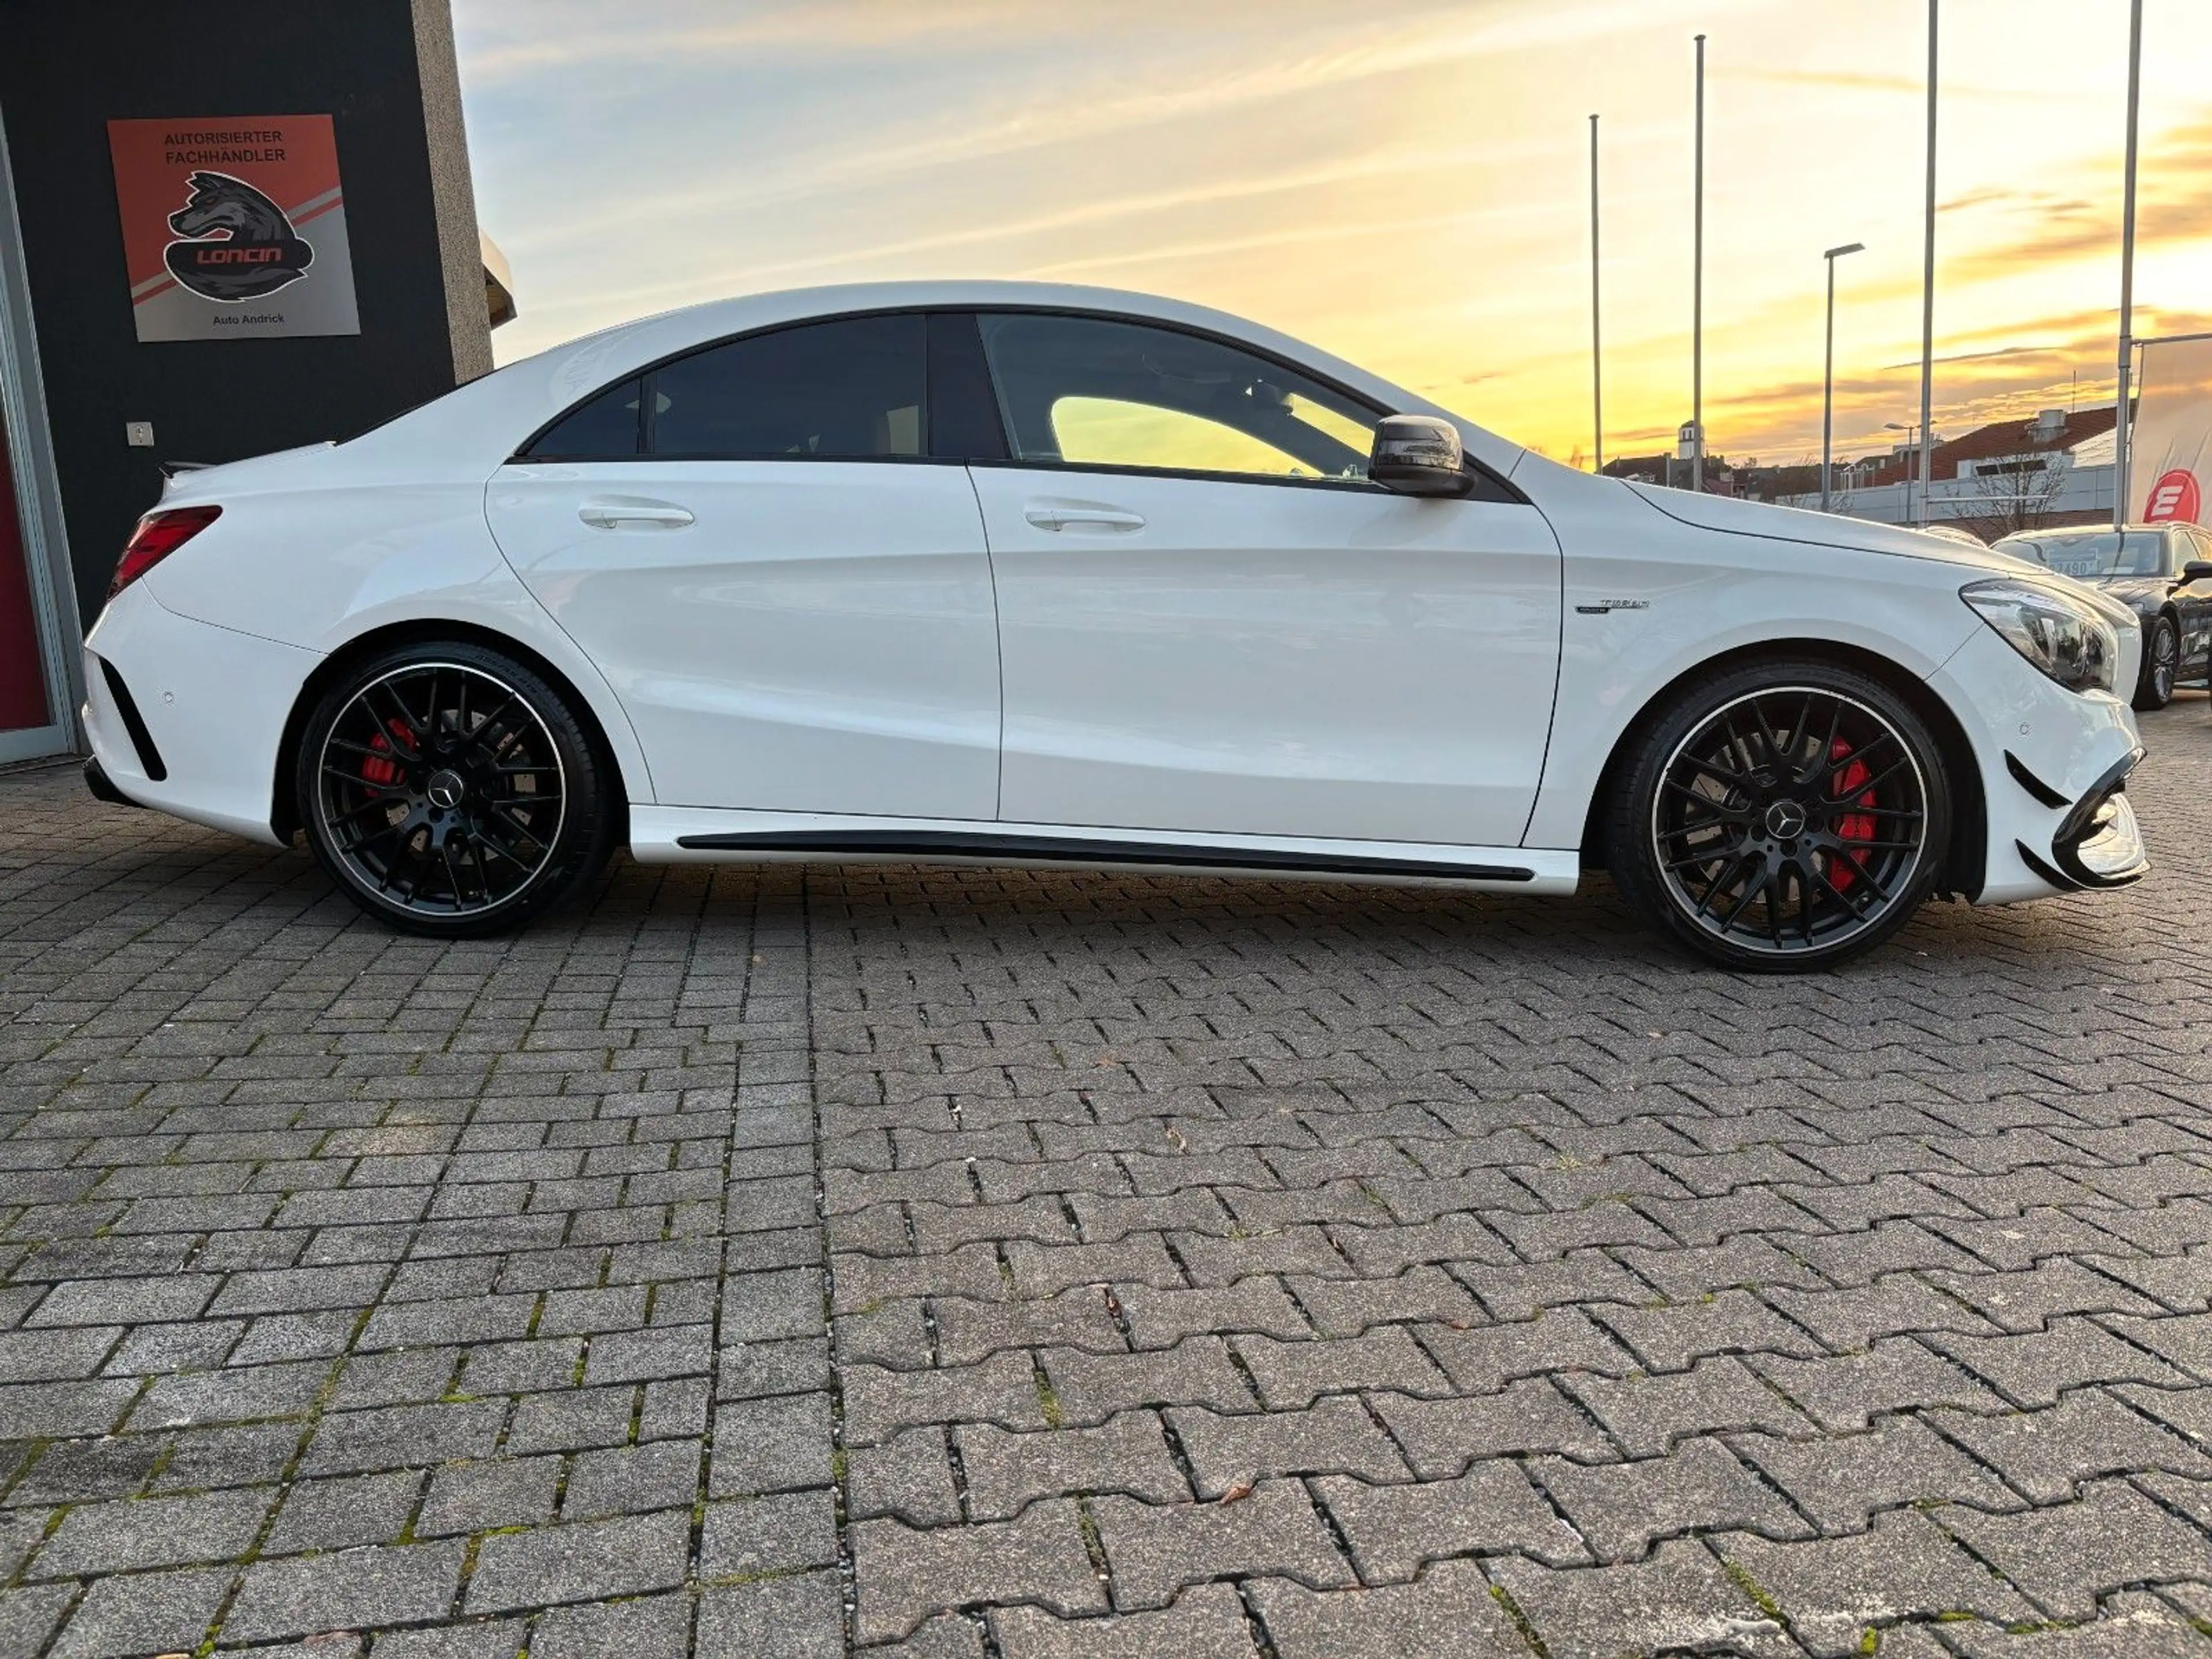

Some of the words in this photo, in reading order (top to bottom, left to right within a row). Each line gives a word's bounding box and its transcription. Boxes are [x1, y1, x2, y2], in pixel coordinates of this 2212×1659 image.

[165, 131, 282, 145] AUTORISIERTER
[166, 147, 286, 164] FACHHÄNDLER
[213, 316, 239, 324] Auto
[242, 313, 285, 324] Andrick
